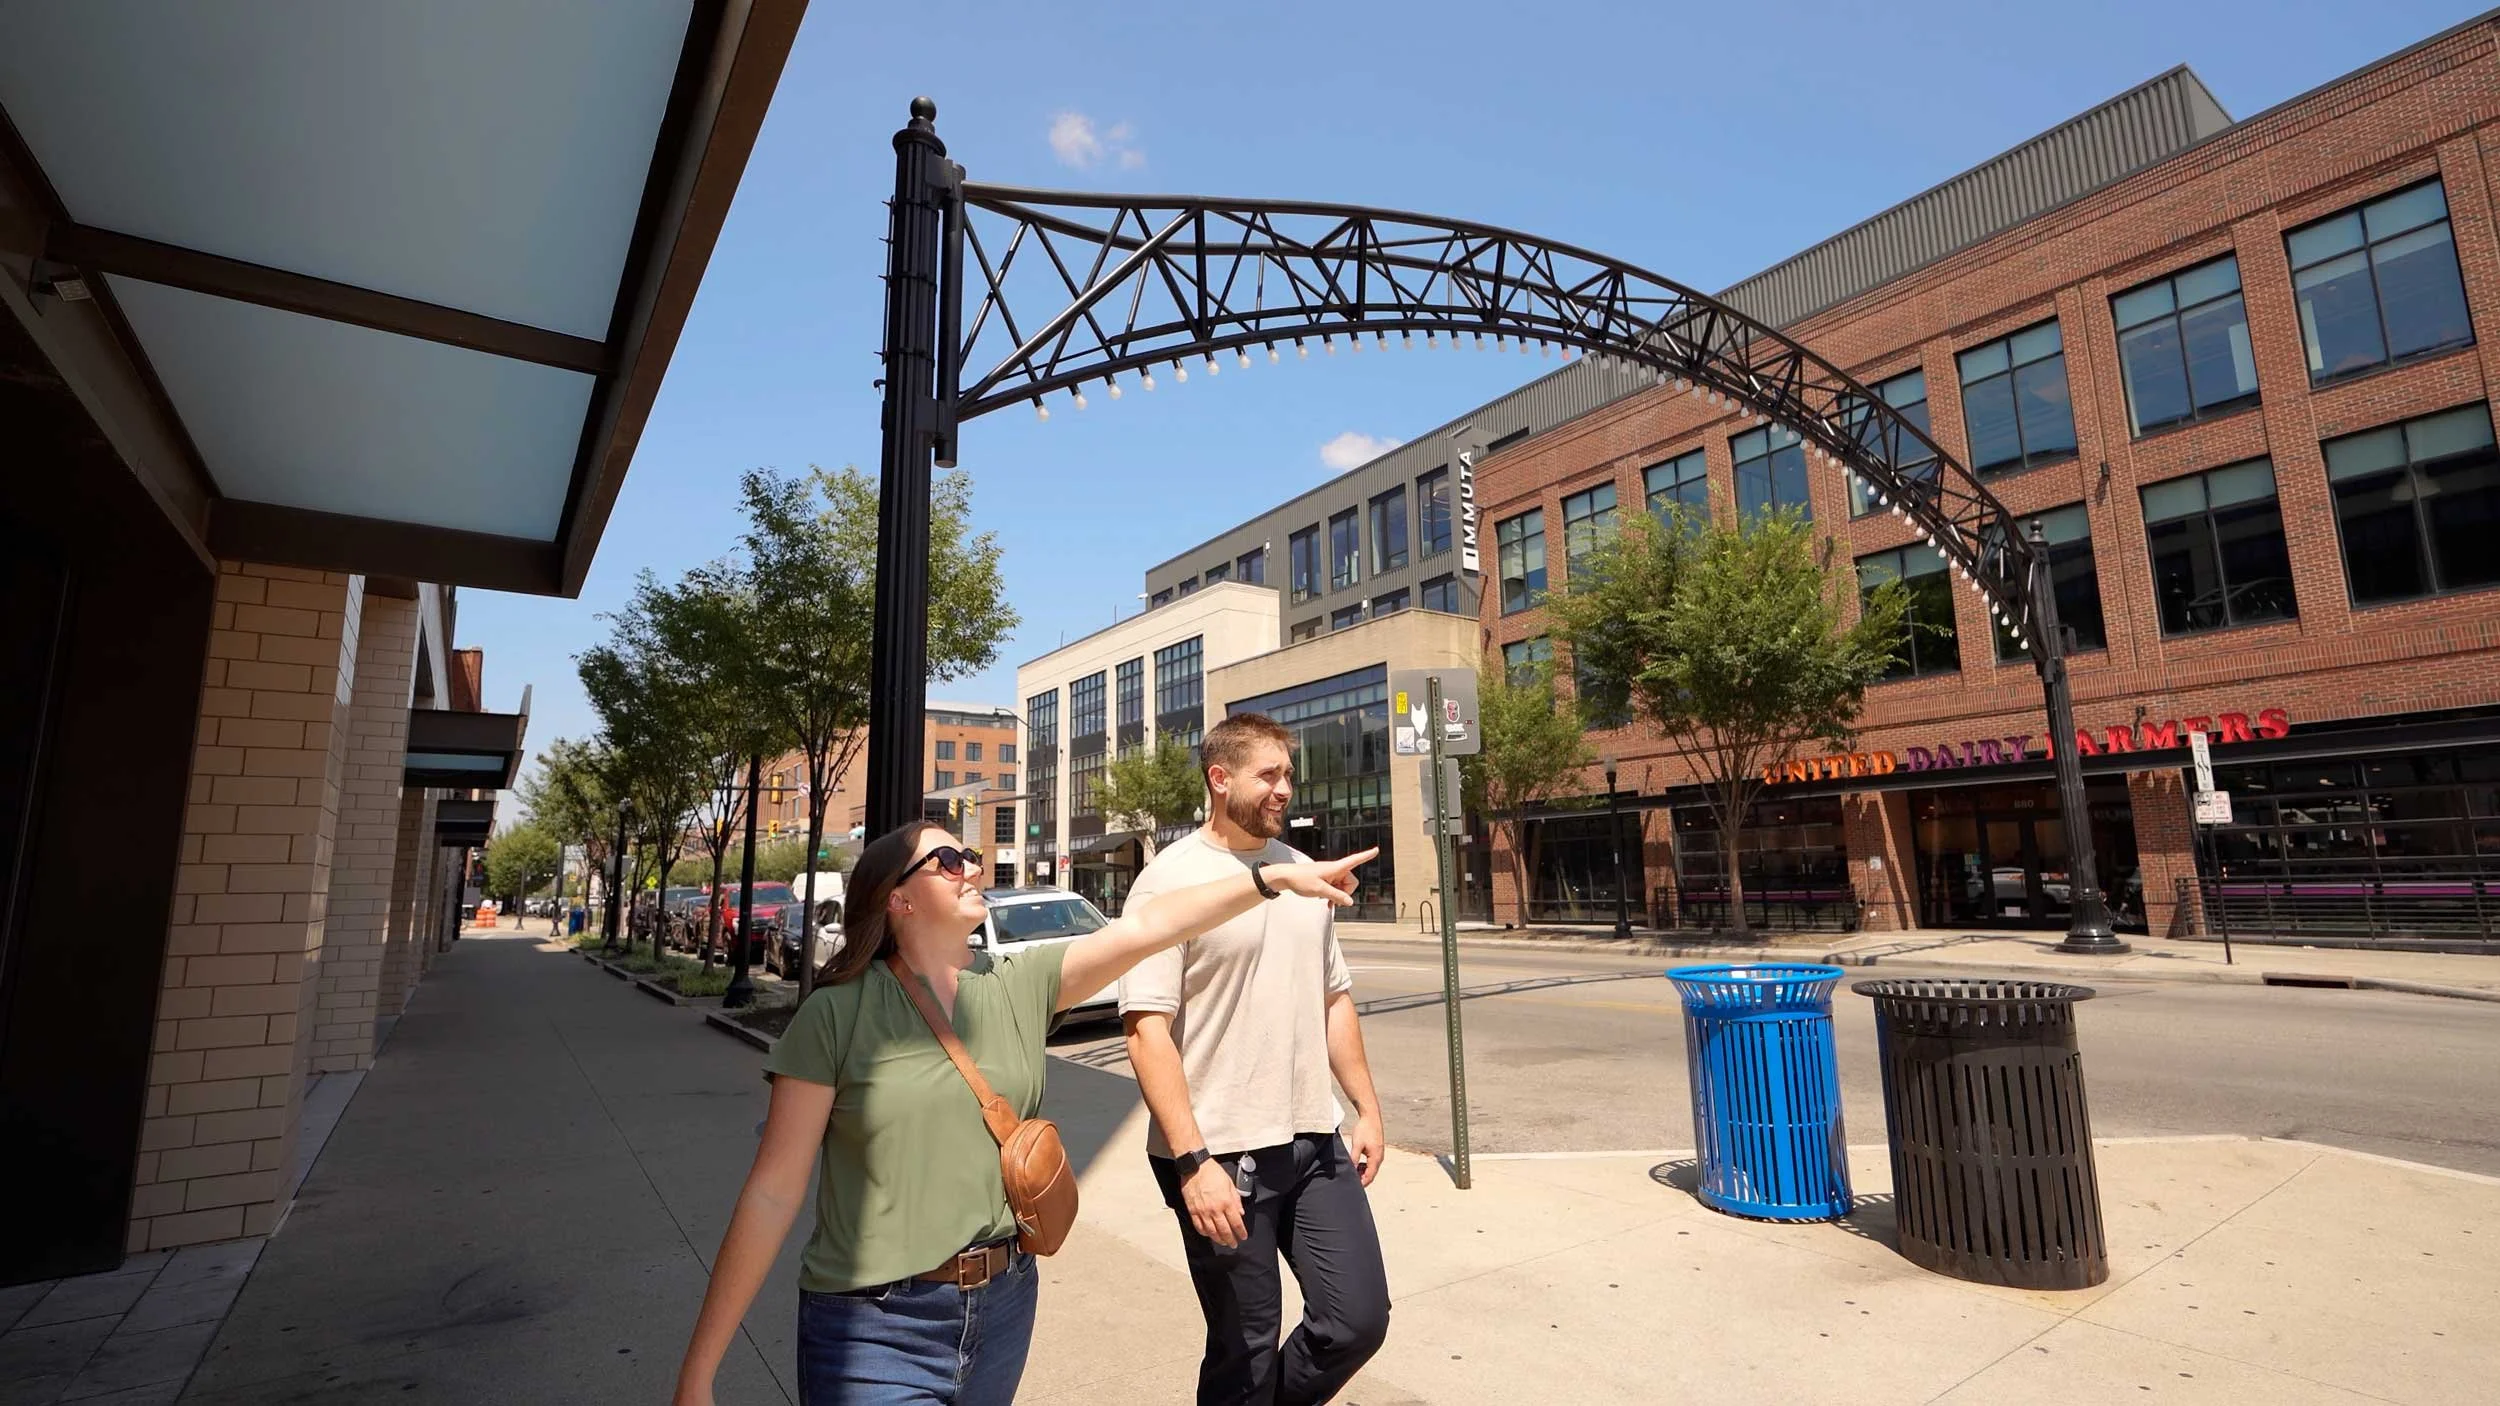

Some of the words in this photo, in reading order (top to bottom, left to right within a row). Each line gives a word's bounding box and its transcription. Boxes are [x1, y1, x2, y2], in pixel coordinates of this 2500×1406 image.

[1459, 450, 1480, 571] IMMUTA
[1762, 751, 1898, 785] UNITED
[1906, 735, 2034, 772] DAIRY
